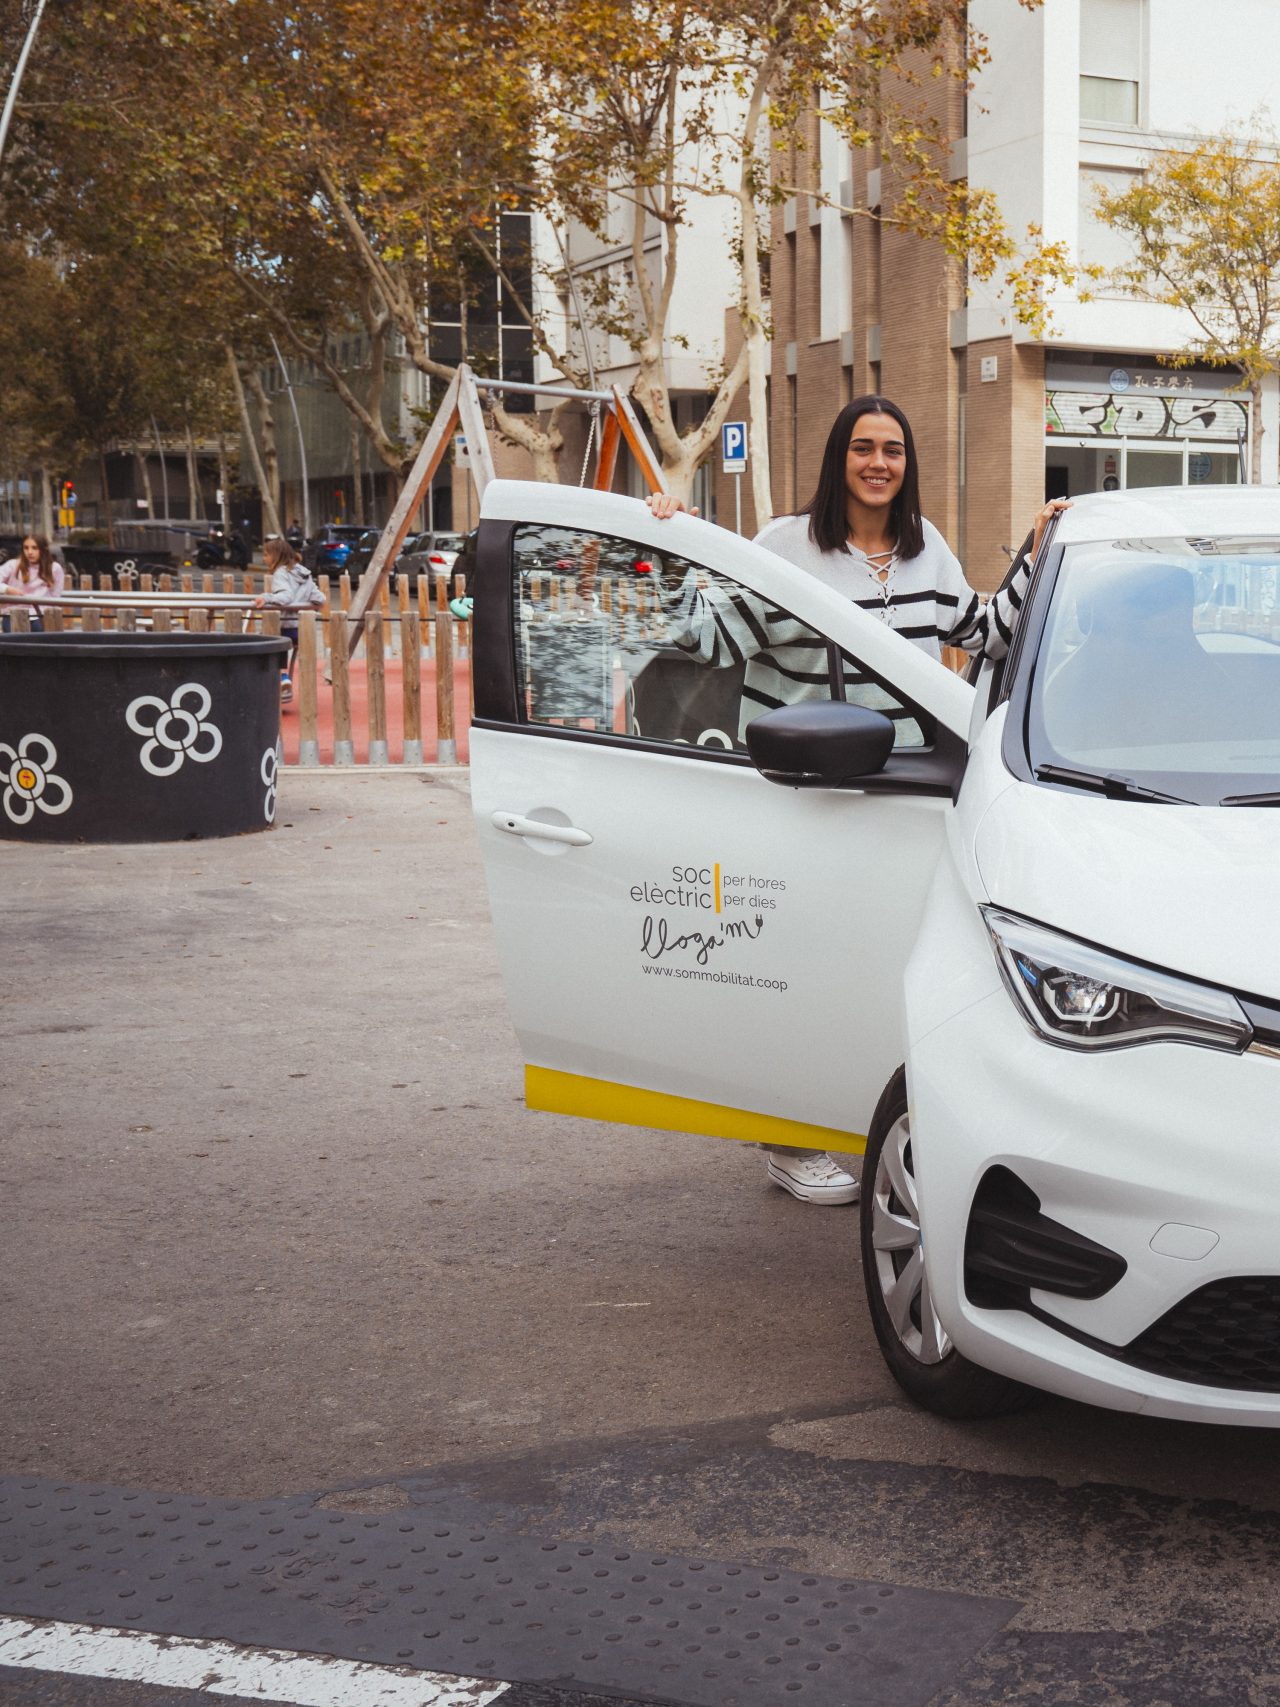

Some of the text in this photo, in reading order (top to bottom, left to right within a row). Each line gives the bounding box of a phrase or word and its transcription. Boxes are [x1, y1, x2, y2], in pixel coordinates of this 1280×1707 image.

[726, 427, 741, 457] P
[630, 881, 712, 909] elèctric
[723, 874, 787, 891] per hores
[723, 894, 777, 910] per dies
[641, 964, 788, 993] www.sommobilitat.coop
